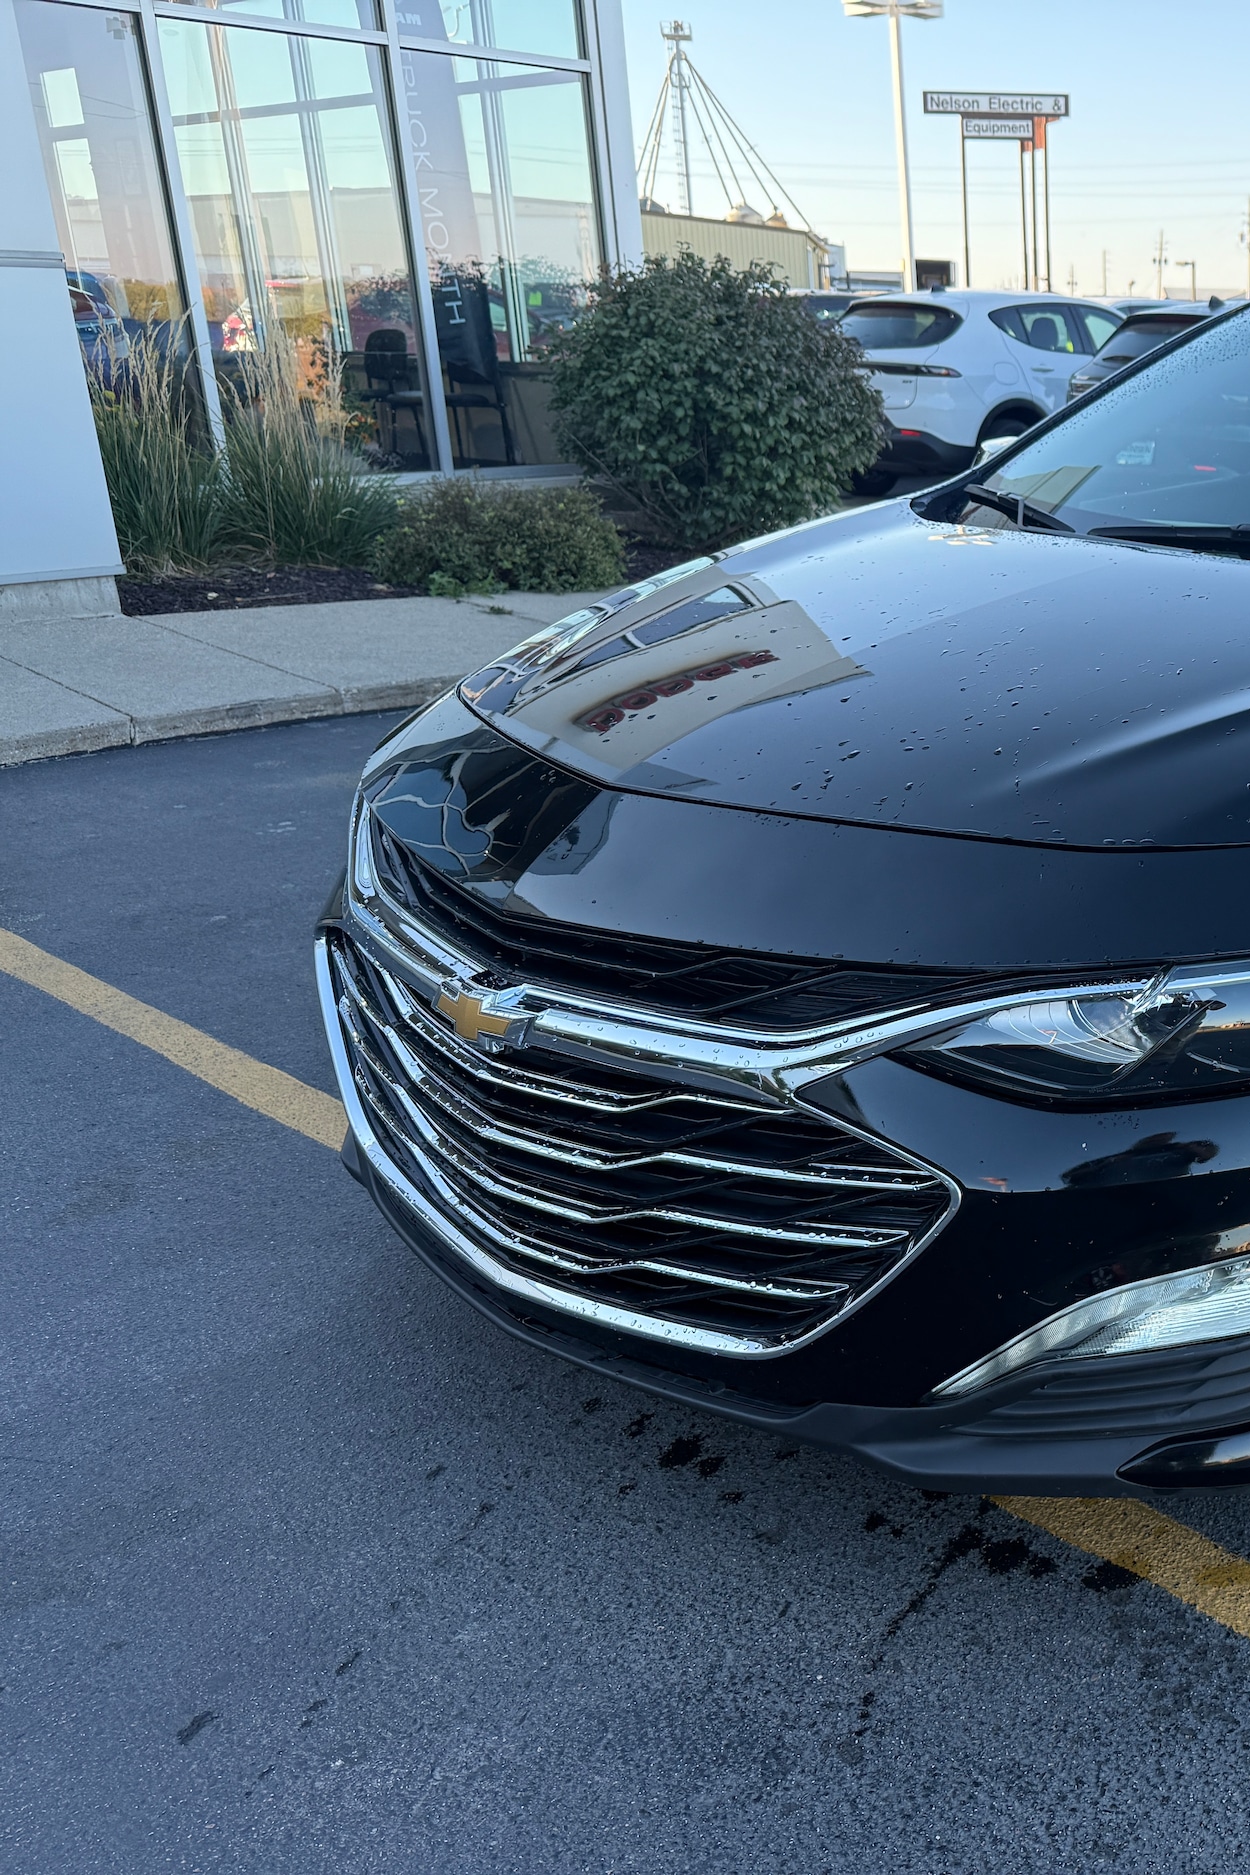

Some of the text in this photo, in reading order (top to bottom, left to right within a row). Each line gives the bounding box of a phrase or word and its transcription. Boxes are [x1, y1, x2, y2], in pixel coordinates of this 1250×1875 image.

[396, 12, 422, 26] AM
[930, 95, 1063, 112] Nelson Electric &
[965, 120, 1031, 136] Equipment
